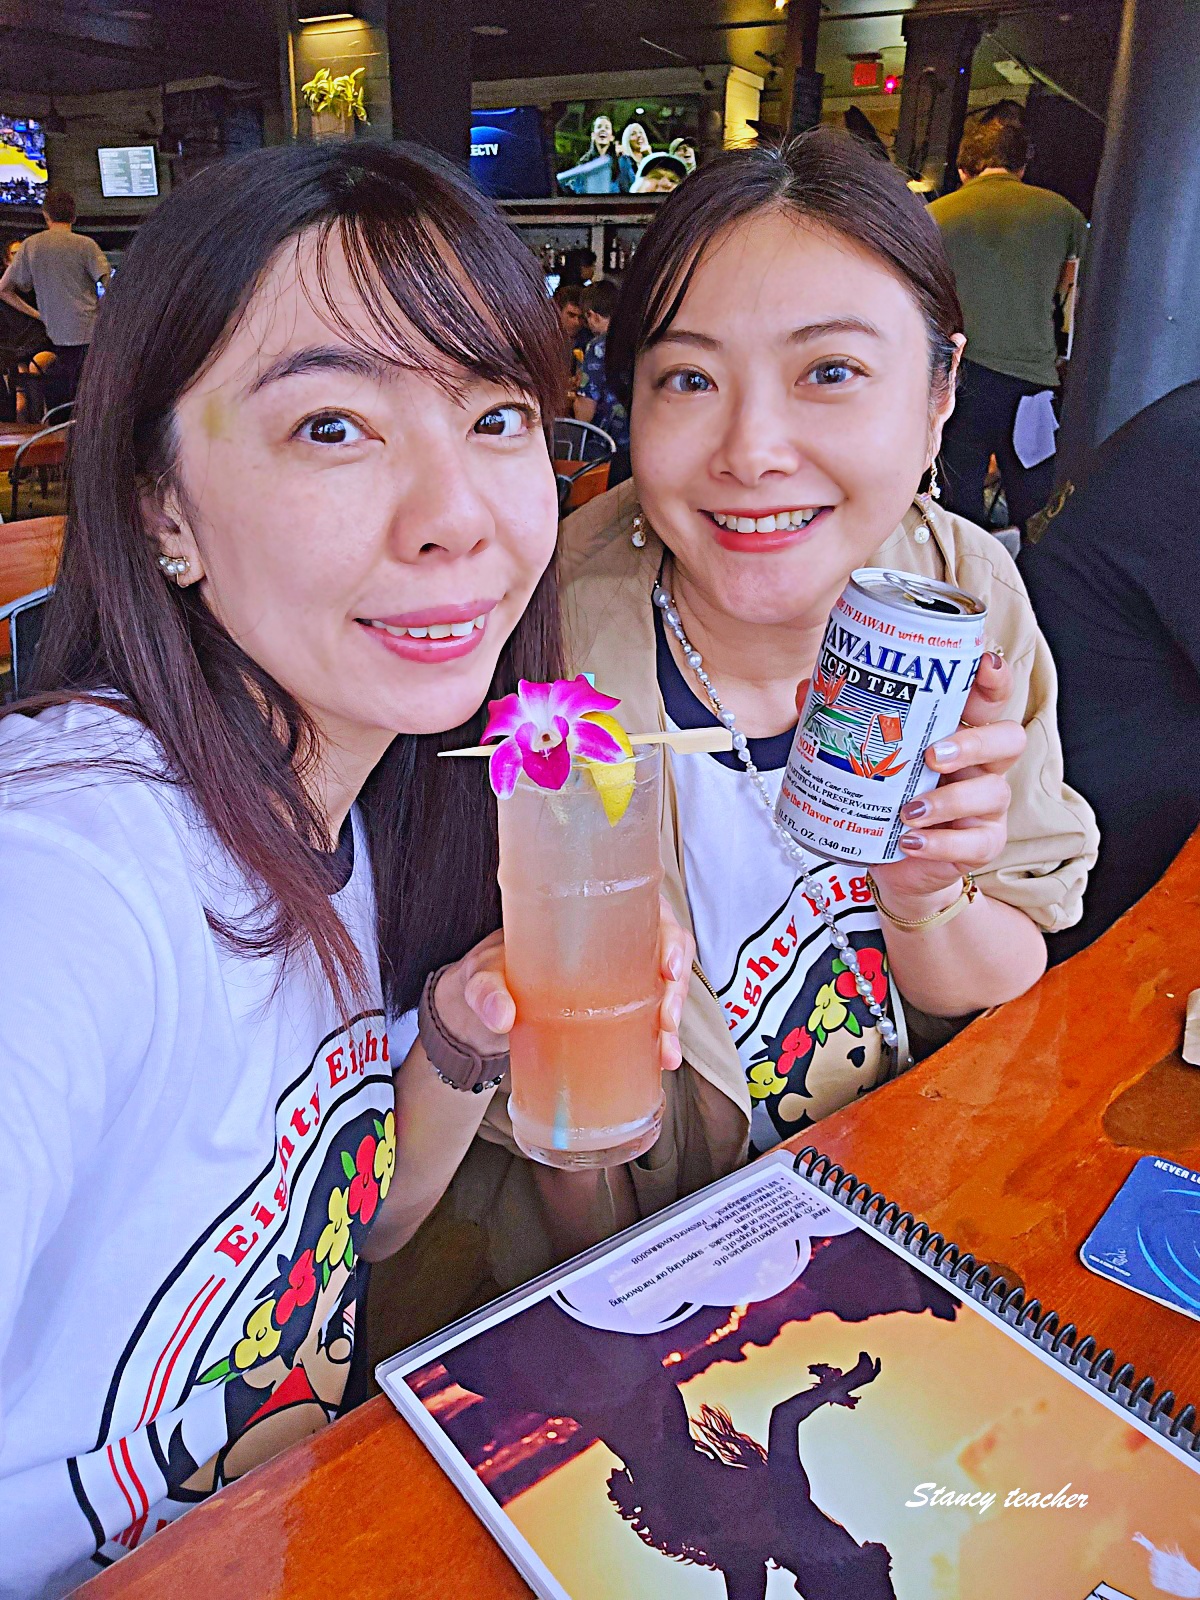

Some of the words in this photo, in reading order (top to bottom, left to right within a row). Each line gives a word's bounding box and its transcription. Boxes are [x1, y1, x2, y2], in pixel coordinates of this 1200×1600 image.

[470, 144, 498, 156] ECTV
[843, 604, 854, 617] IN
[852, 610, 897, 636] HAWAII
[898, 630, 925, 645] with
[928, 636, 962, 648] Aloha!
[822, 651, 861, 684] ICED
[867, 675, 911, 700] TEA
[812, 776, 824, 784] with
[825, 781, 842, 791] Cane
[841, 788, 864, 798] Sugar
[822, 789, 892, 813] PRESERVATIVES
[791, 794, 801, 808] the
[802, 801, 832, 824] Flavor
[833, 819, 846, 829] of
[846, 821, 884, 837] Hawaii
[787, 818, 798, 832] FL.
[800, 827, 816, 842] OZ.
[818, 837, 839, 850] (340
[840, 846, 862, 857] mL)
[725, 915, 798, 1031] ighty
[802, 875, 873, 916] Eig
[214, 1082, 321, 1267] Eighty
[325, 1029, 390, 1089] Eight
[1153, 1159, 1190, 1179] NEVER
[777, 1189, 794, 1200] back
[722, 1209, 740, 1222] time
[751, 1200, 772, 1215] house
[768, 1199, 793, 1217] kitchen
[734, 1211, 753, 1225] team
[748, 1217, 758, 1229] on
[757, 1211, 771, 1221] fee
[767, 1209, 789, 1225] checks
[776, 1210, 802, 1229] gratuity
[704, 1217, 724, 1232] policy
[758, 1221, 770, 1231] for
[725, 1227, 743, 1240] food
[735, 1226, 759, 1243] groups
[751, 1236, 760, 1245] to
[758, 1225, 778, 1242] added
[709, 1236, 726, 1249] sales
[727, 1240, 752, 1258] parties
[728, 1239, 738, 1249] of
[666, 1248, 704, 1273] supporting
[719, 1254, 729, 1265] of
[655, 1270, 668, 1281] our
[609, 1278, 656, 1308] hardworking
